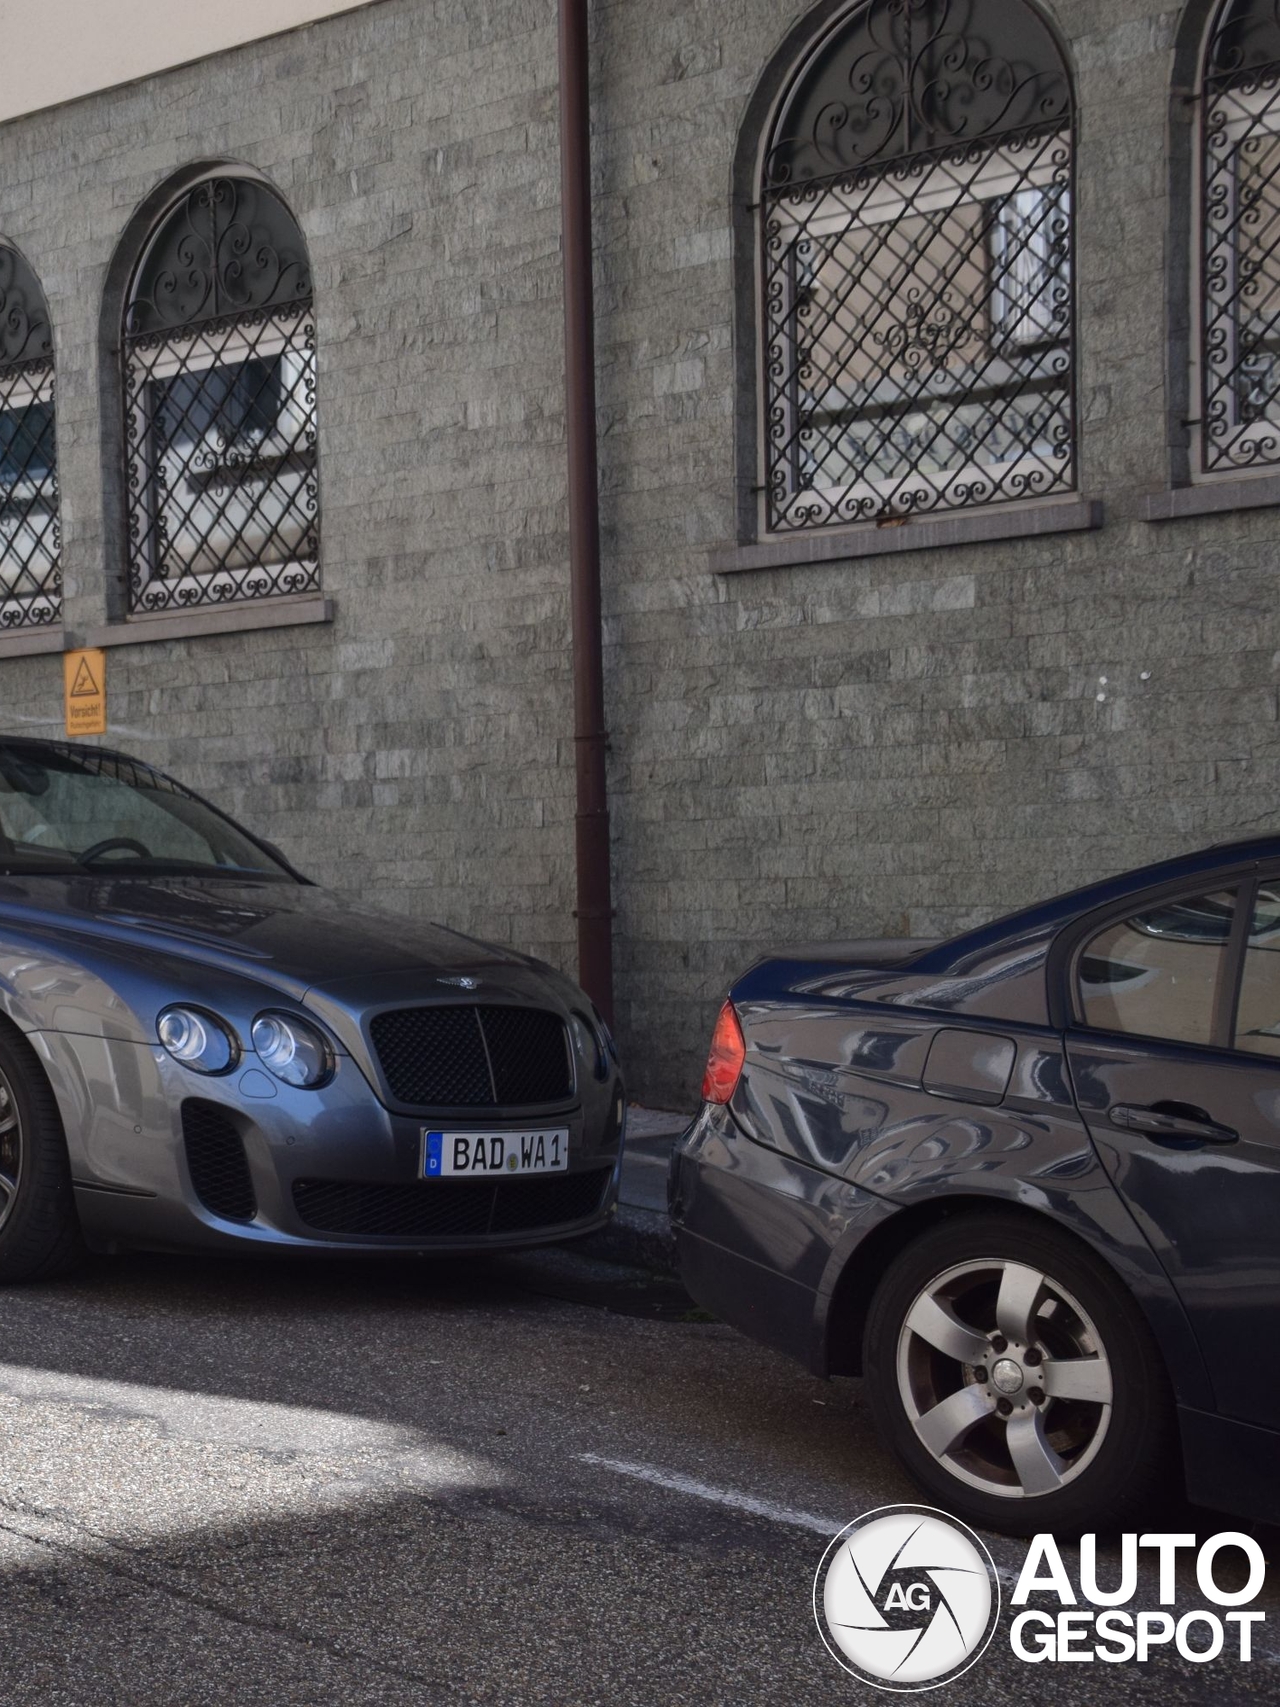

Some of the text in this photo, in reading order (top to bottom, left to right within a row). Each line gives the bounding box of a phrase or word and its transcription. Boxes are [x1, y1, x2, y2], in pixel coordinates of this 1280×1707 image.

[70, 703, 101, 719] Vorsicht!
[452, 1137, 505, 1170] BAD
[430, 1158, 437, 1169] D
